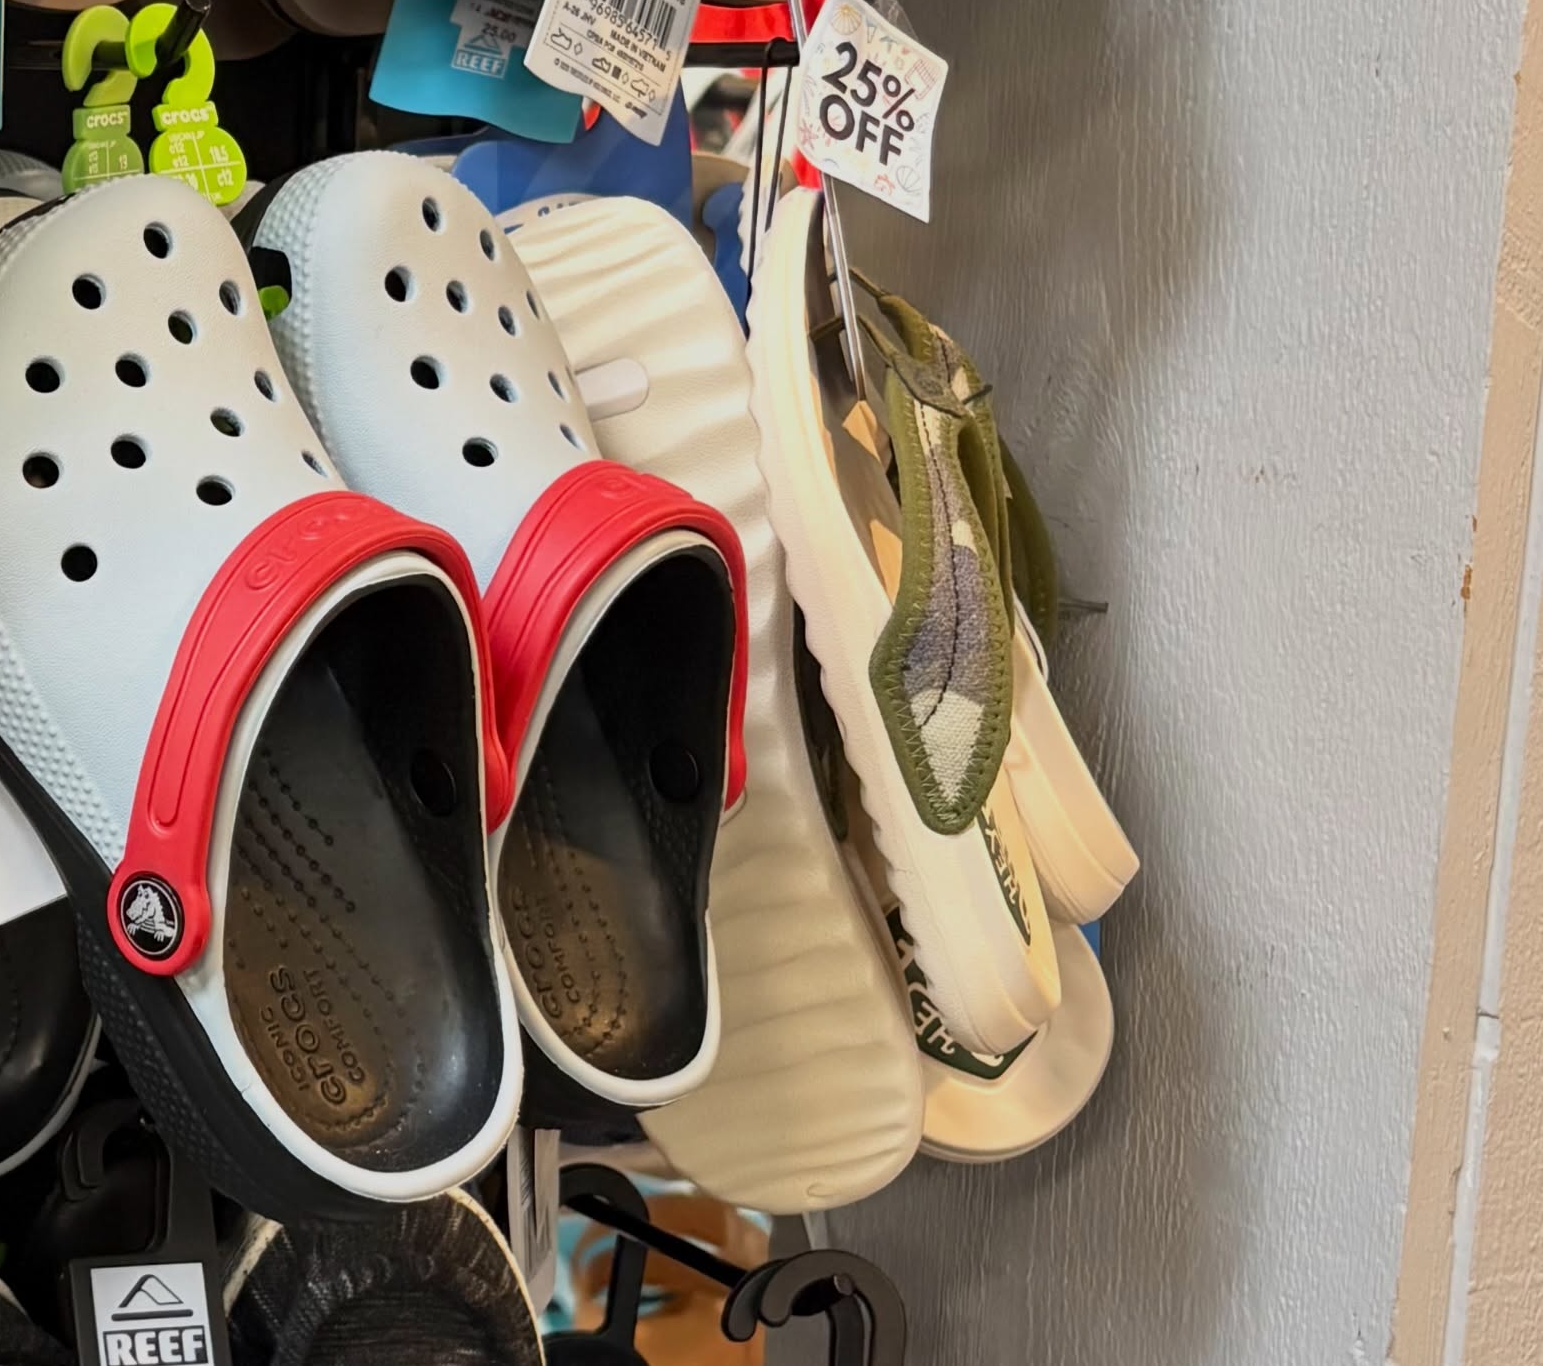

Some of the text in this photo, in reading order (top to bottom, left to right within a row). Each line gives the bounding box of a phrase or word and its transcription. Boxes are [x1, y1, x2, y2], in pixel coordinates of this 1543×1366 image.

[457, 52, 503, 74] REEF
[637, 46, 667, 74] VIETNAM
[821, 40, 915, 133] 25%
[818, 93, 905, 166] OFF
[511, 886, 563, 1020] crocs
[259, 1005, 310, 1092] ICONIC
[268, 965, 348, 1106] crocs
[302, 969, 366, 1085] COMFORT
